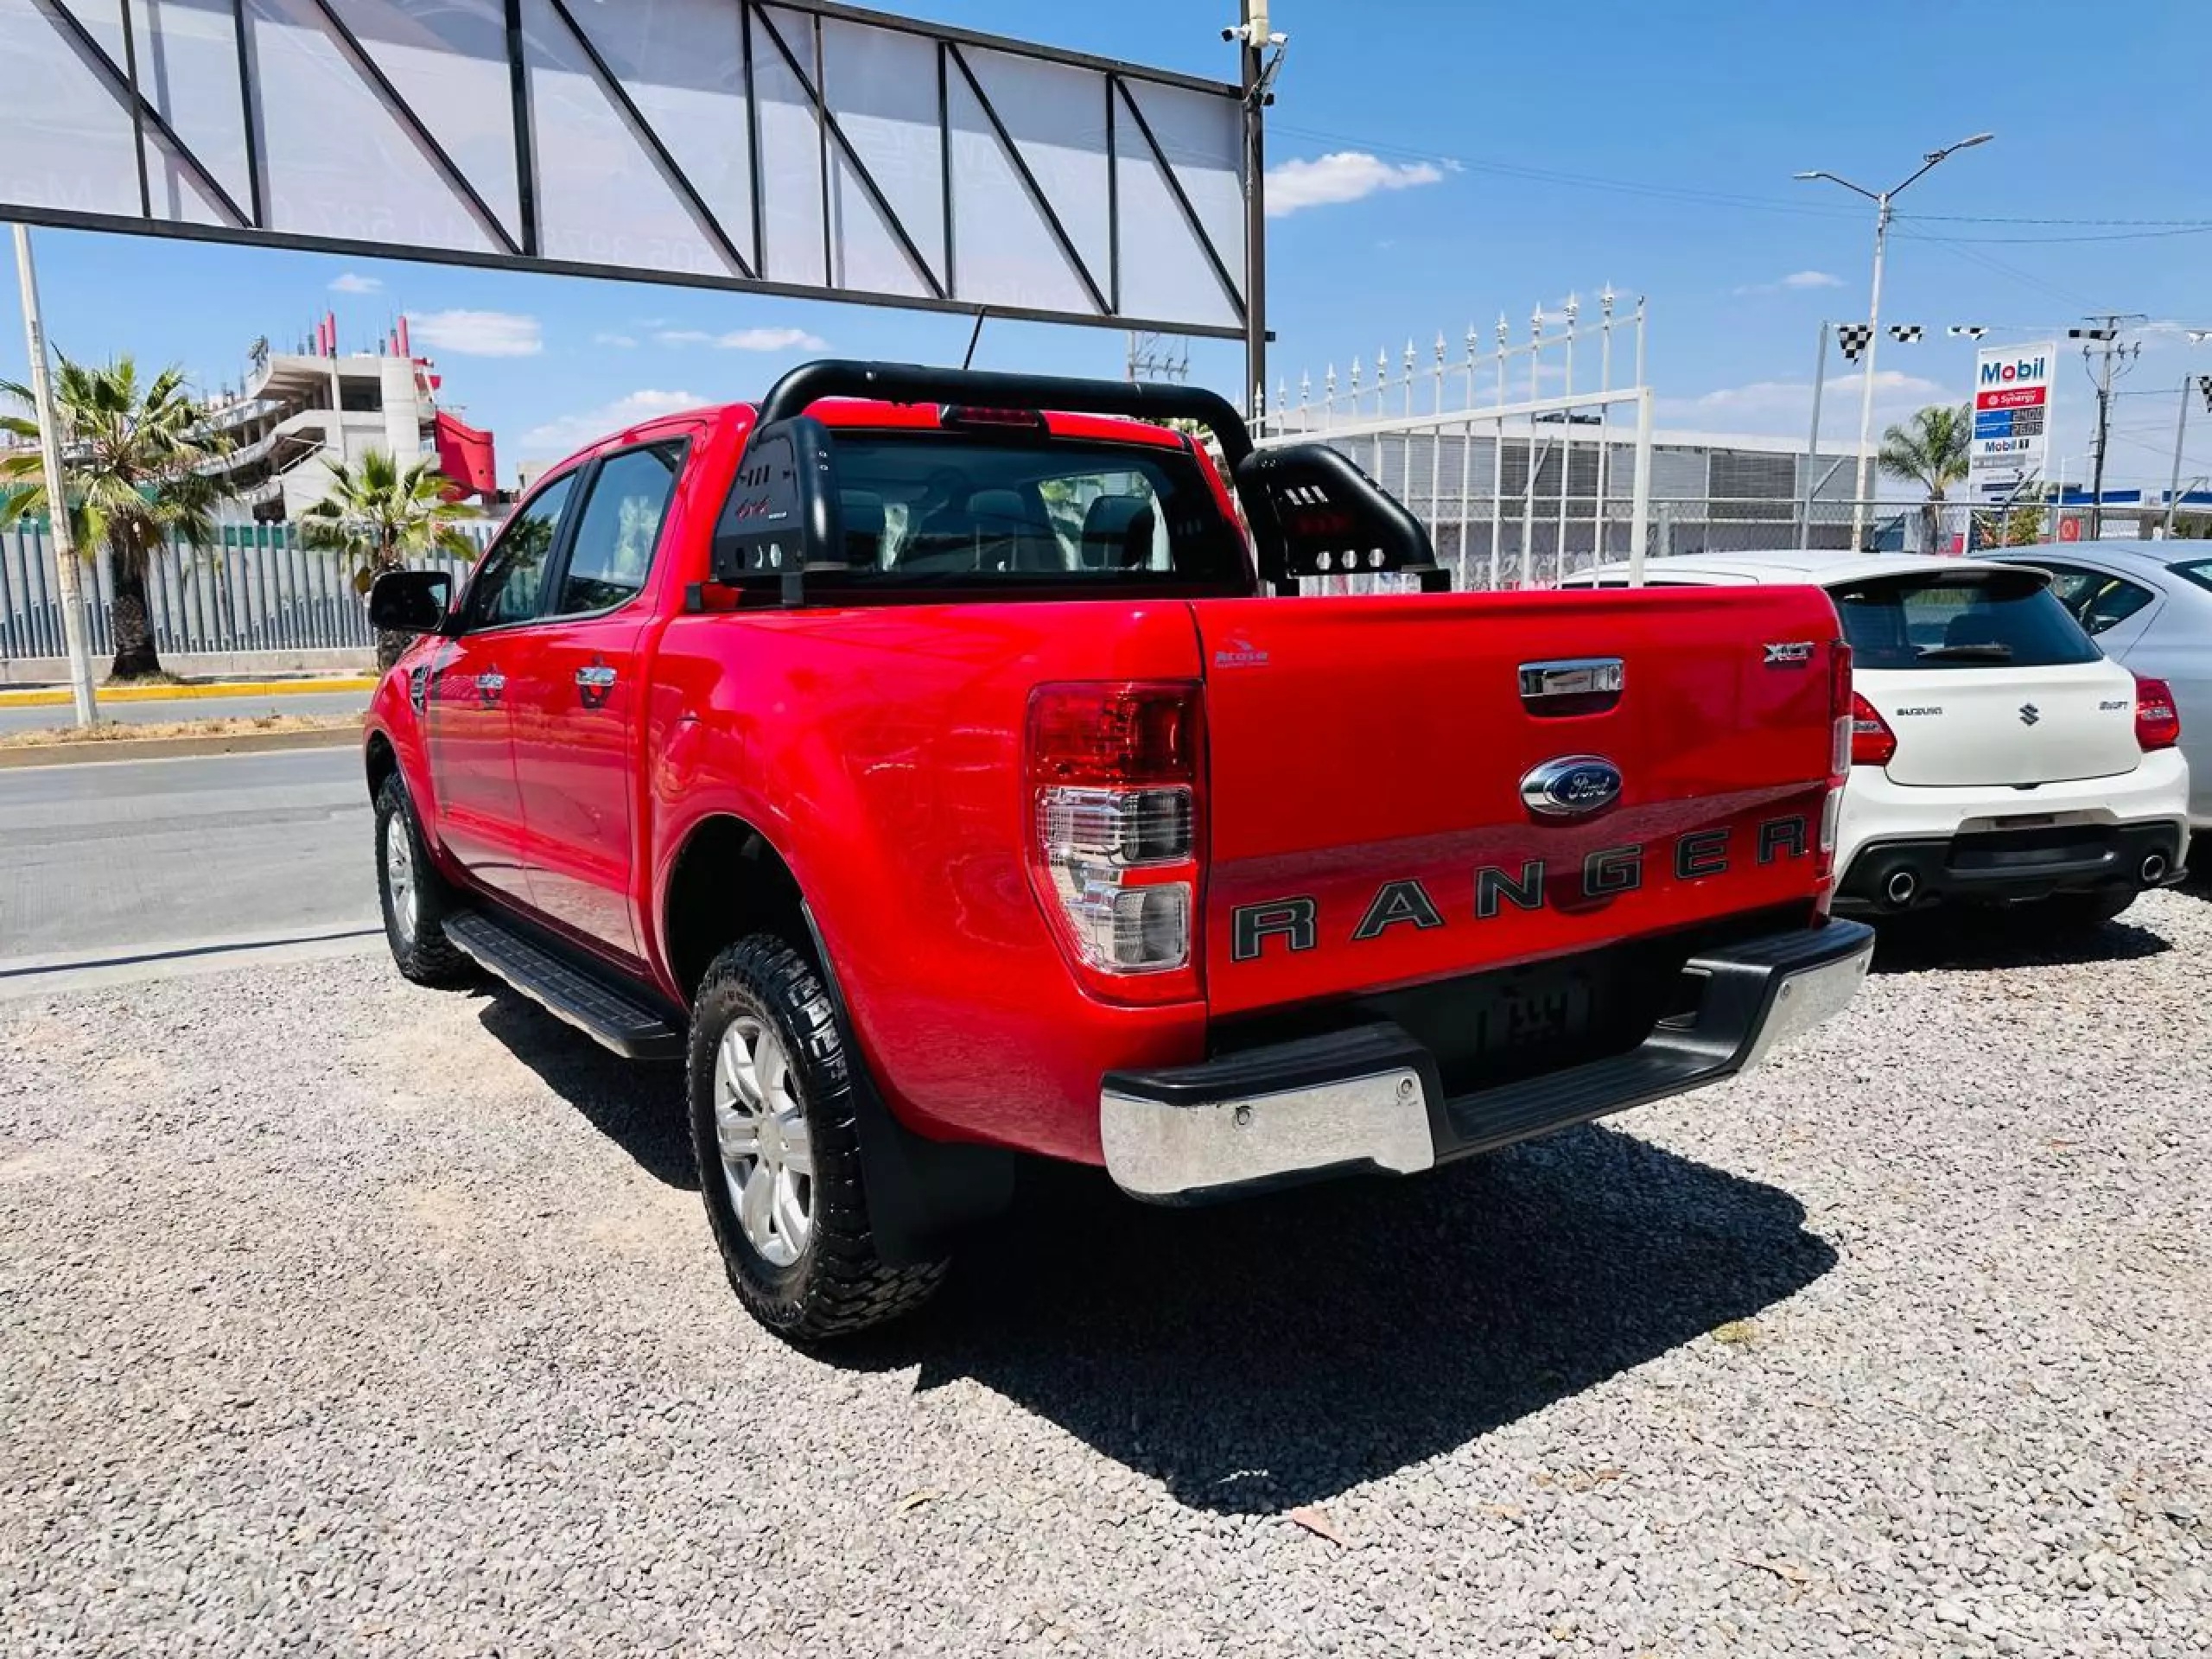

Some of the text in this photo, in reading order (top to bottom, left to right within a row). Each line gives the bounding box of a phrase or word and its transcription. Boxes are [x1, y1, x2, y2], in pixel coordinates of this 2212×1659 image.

[1980, 357, 2045, 385] Mobil
[1567, 772, 1611, 799] Ford
[1230, 814, 1808, 963] RANGER
